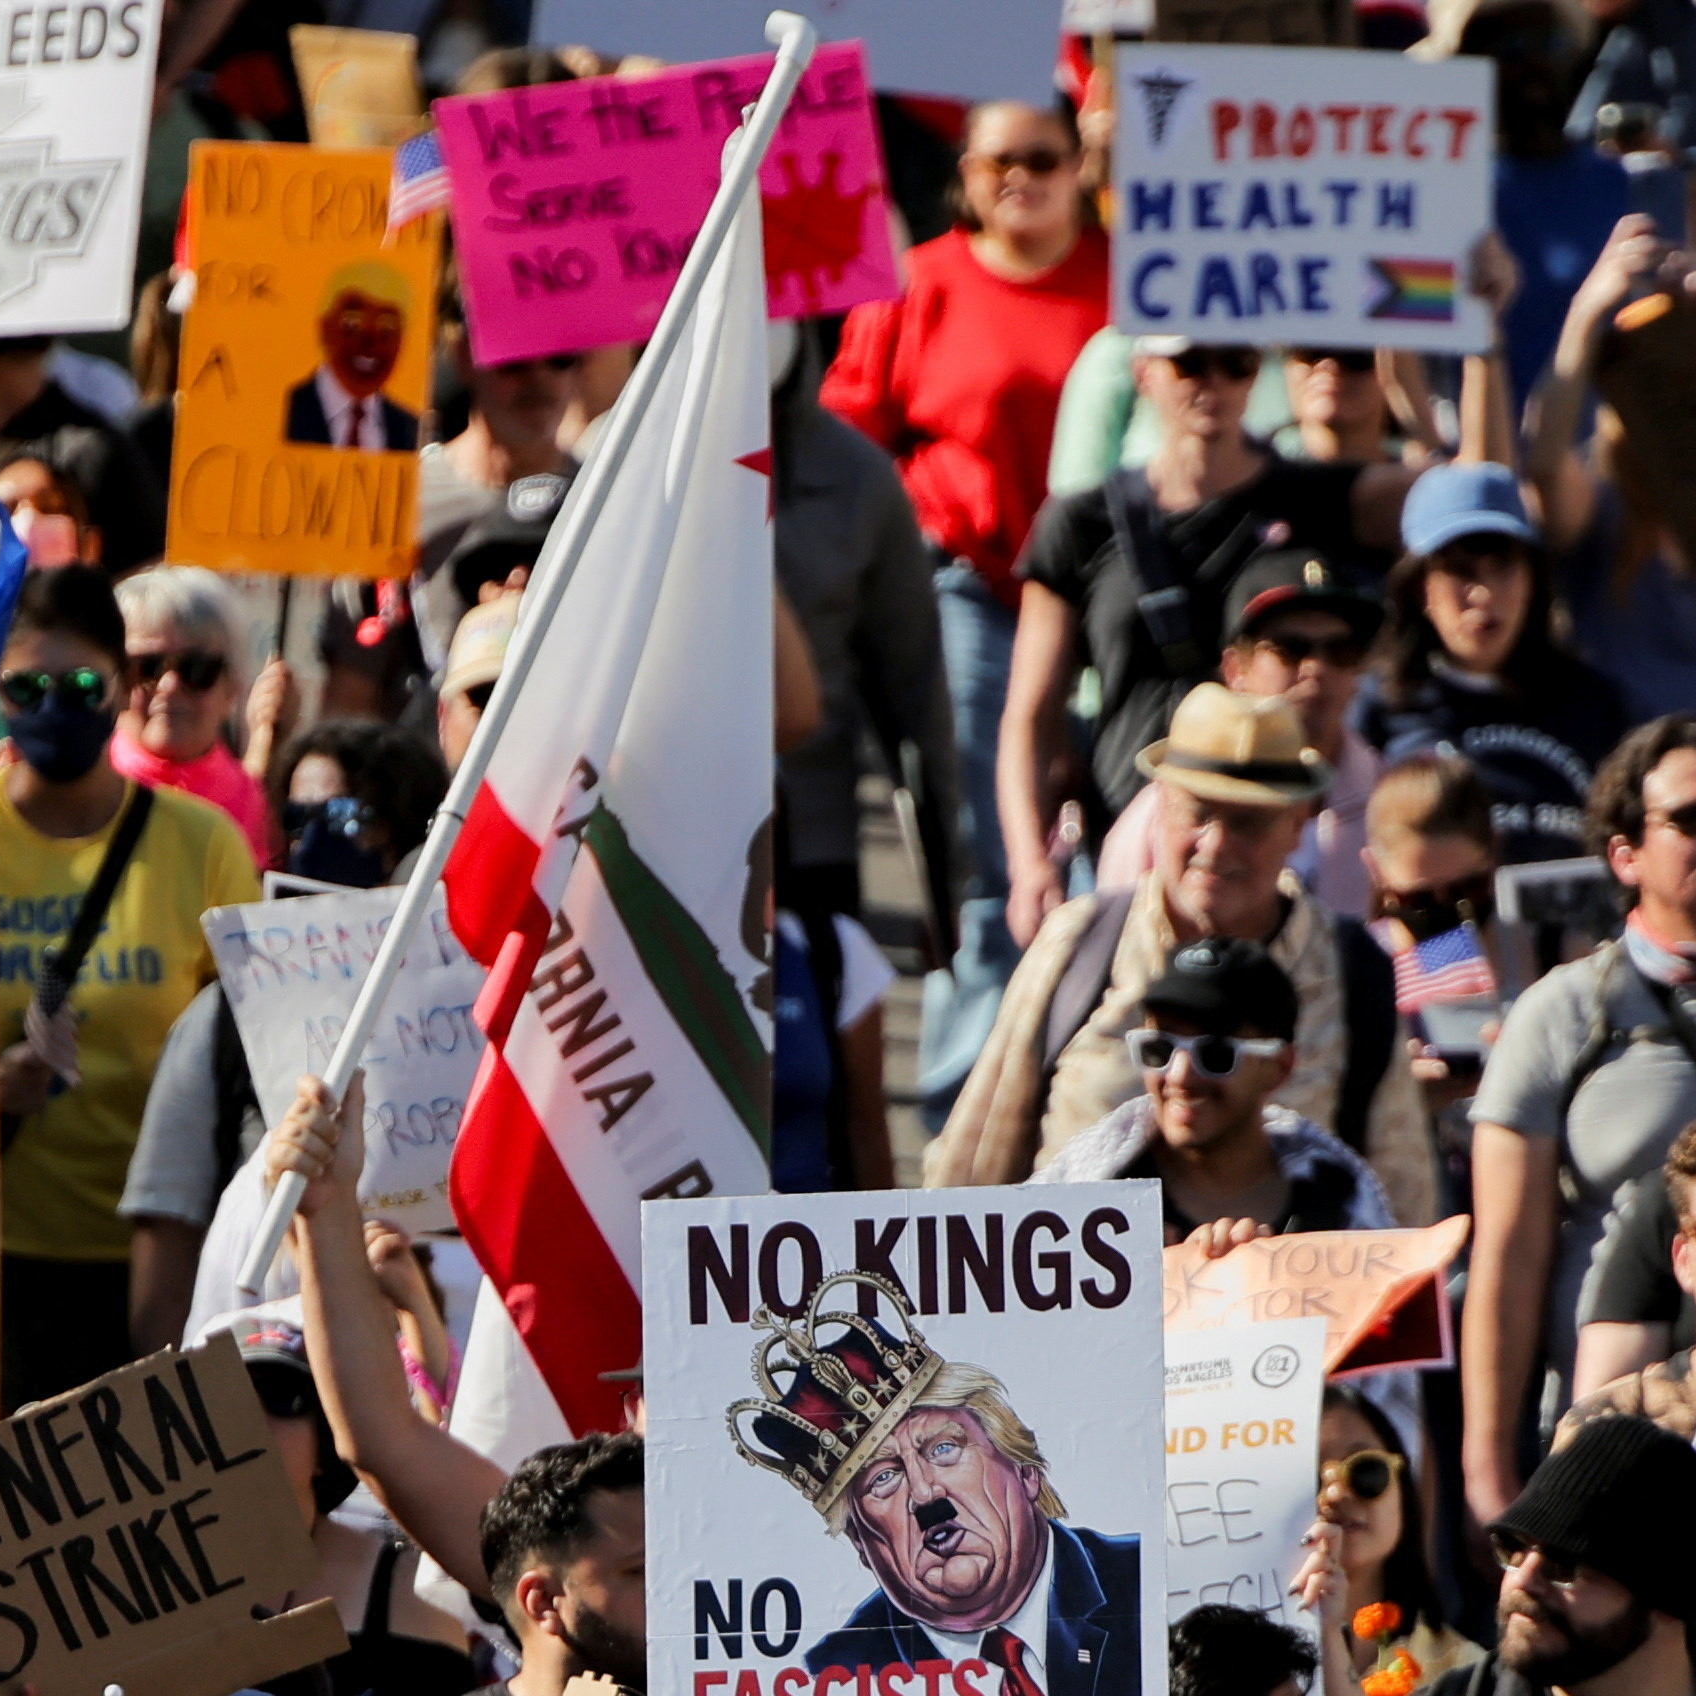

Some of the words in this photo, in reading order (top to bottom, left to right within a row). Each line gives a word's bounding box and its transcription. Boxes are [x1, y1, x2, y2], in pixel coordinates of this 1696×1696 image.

[1210, 101, 1482, 163] PROTECT
[203, 155, 271, 216] NO
[1128, 180, 1419, 234] HEALTH
[195, 259, 281, 310] FOR
[508, 245, 598, 296] NO
[1130, 255, 1331, 320] CARE
[192, 343, 237, 399] A
[177, 442, 411, 544] CLOWN!
[686, 1218, 823, 1325] NO
[855, 1206, 1133, 1318] KINGS
[1249, 1239, 1403, 1283] YOUR
[1221, 1418, 1296, 1452] FOR
[691, 1576, 802, 1661] NO
